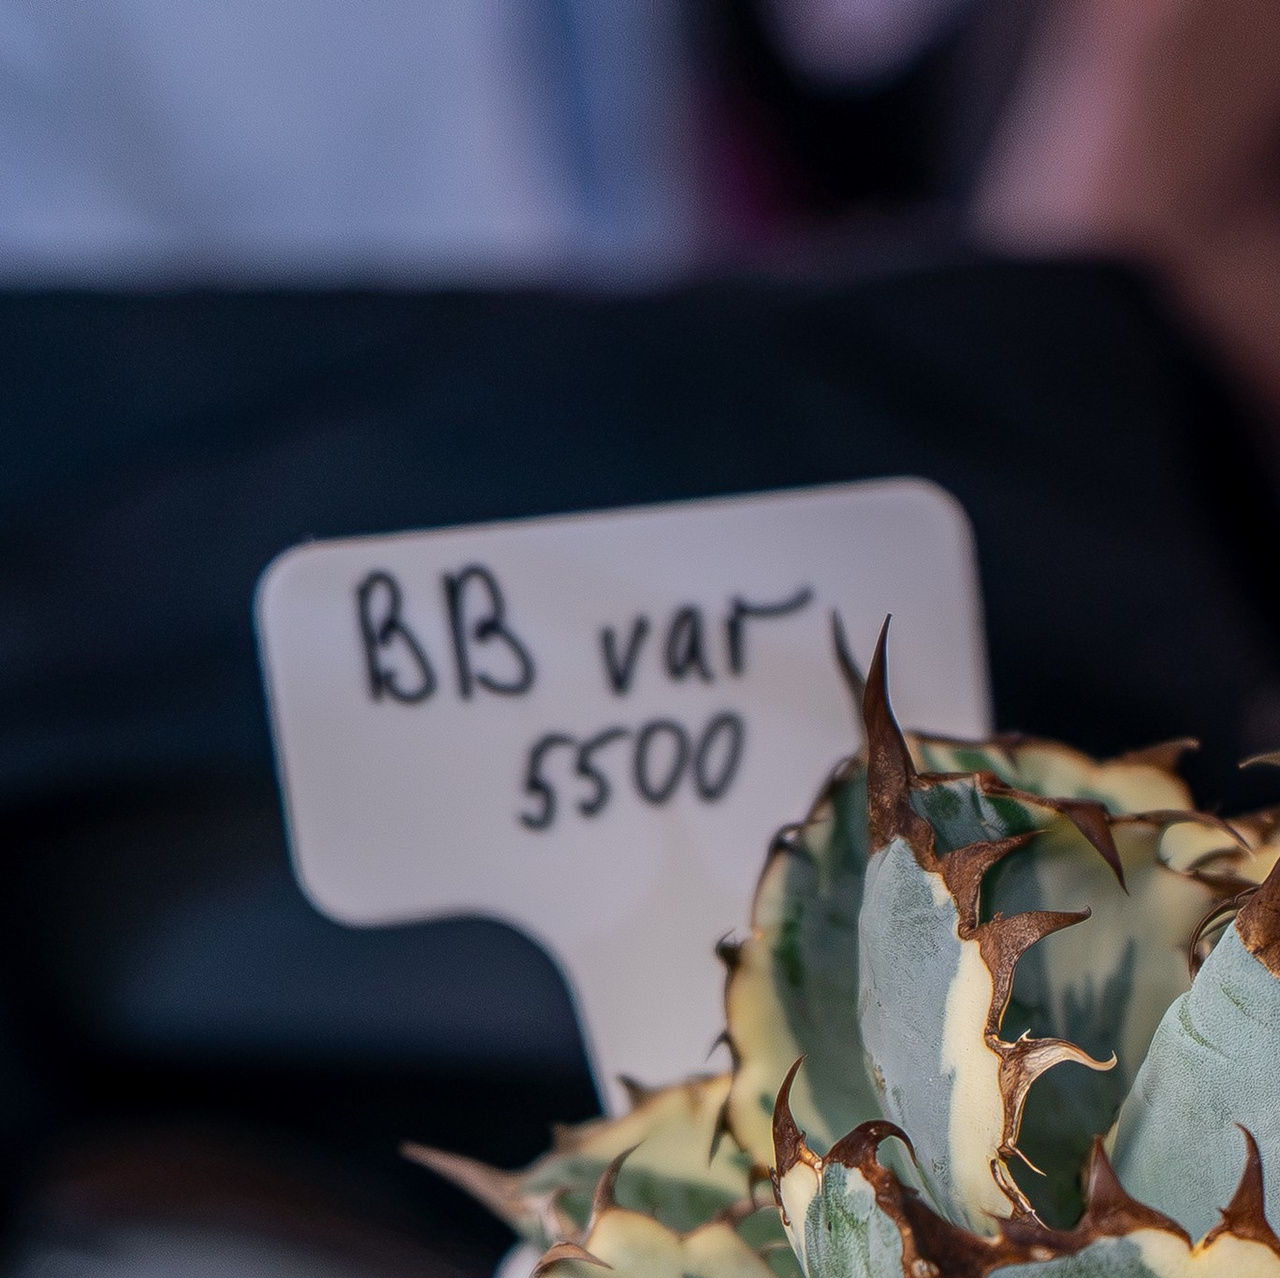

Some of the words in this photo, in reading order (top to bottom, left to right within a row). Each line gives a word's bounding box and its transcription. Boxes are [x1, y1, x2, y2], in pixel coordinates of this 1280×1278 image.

[354, 560, 536, 704] BB
[600, 584, 814, 697] var
[517, 710, 747, 832] 5500
